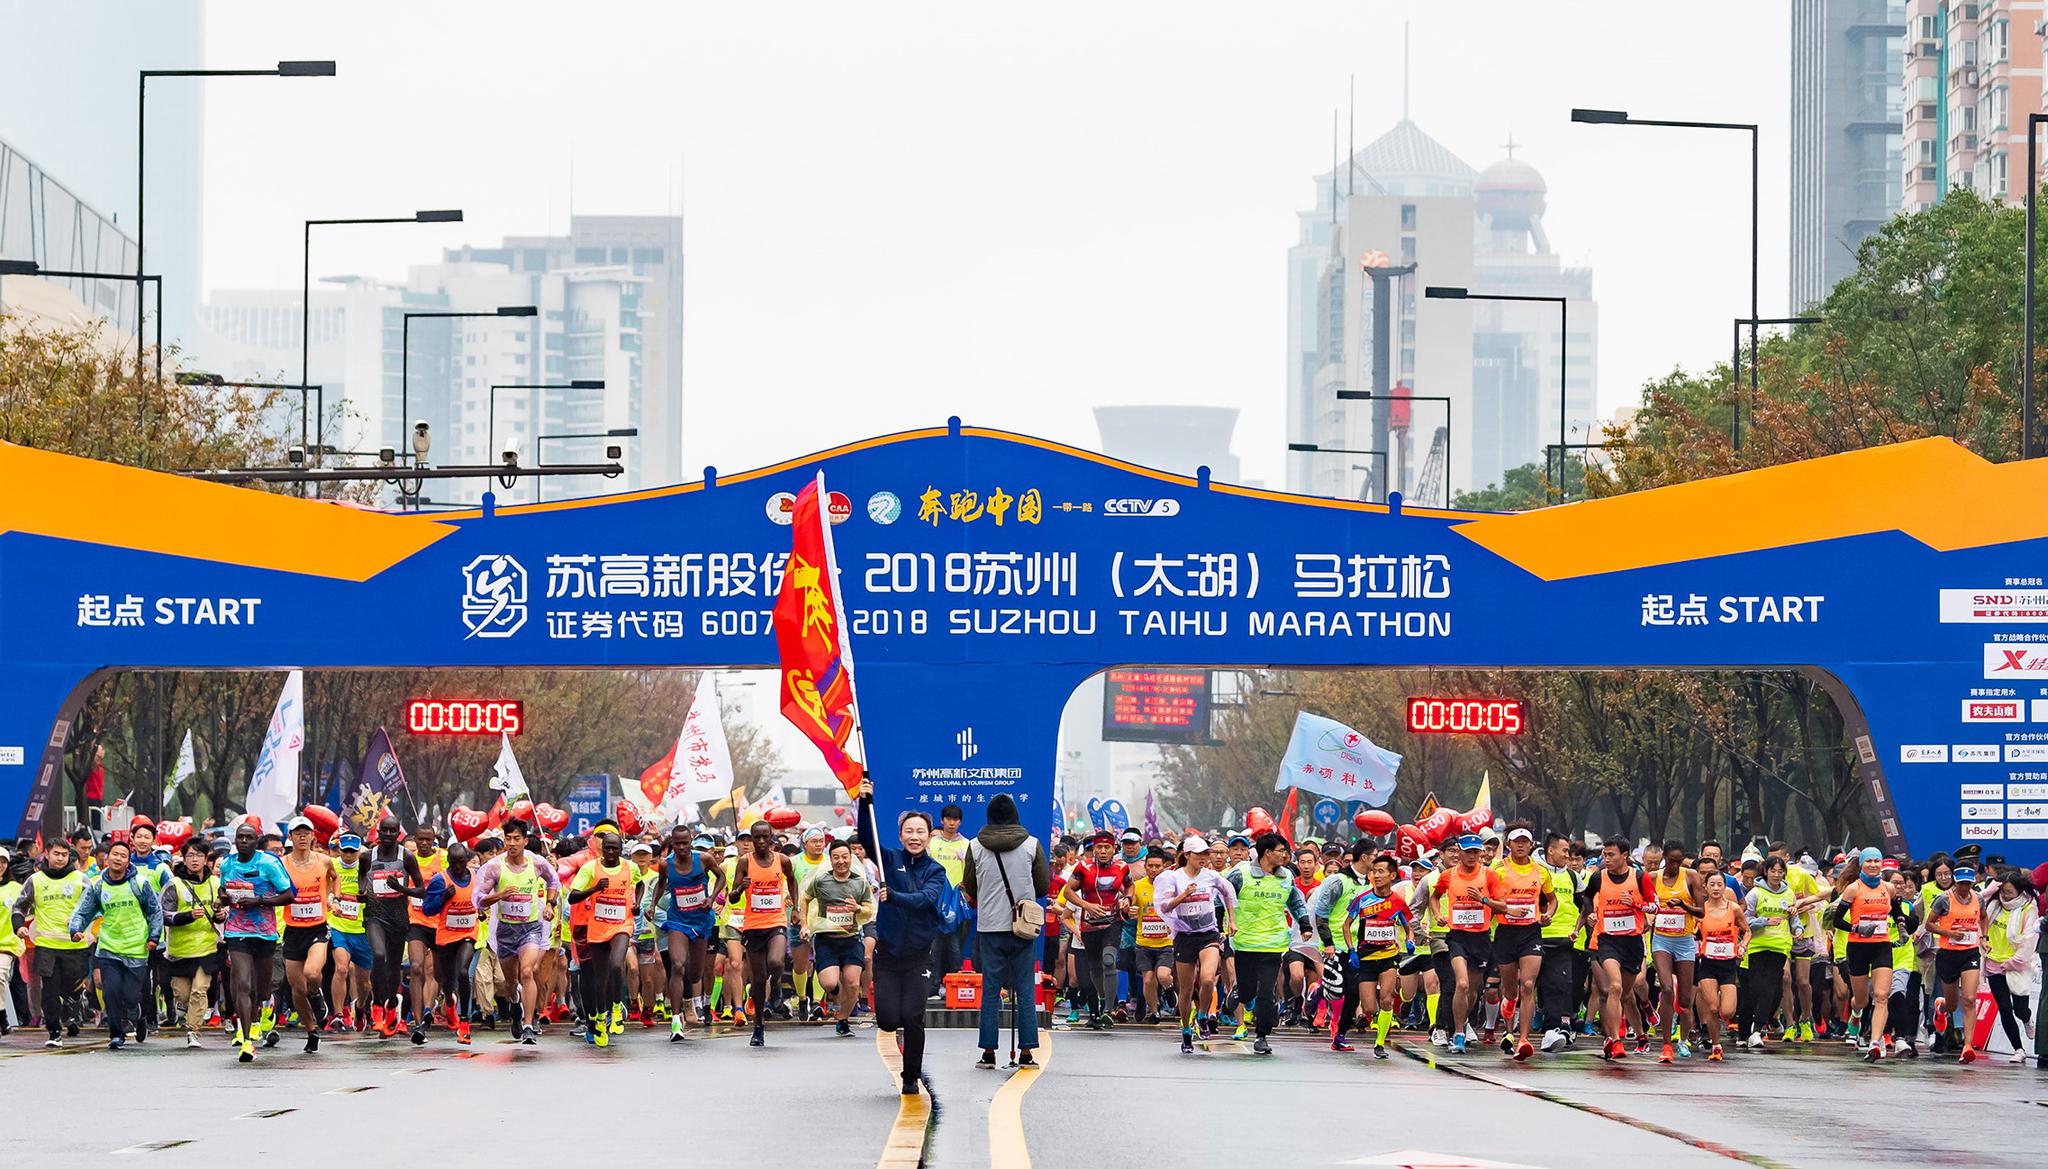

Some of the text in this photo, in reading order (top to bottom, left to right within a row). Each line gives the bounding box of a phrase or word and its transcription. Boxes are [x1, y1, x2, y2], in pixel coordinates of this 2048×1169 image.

[918, 485, 1042, 528] 奔跑中国
[1104, 499, 1153, 513] CCTV
[1973, 595, 2013, 605] SND
[77, 594, 262, 627] 起点 START
[1640, 593, 1825, 627] 起点 START
[546, 610, 684, 639] 证券代码
[851, 608, 1452, 637] 2018 SUZHOU TAIHU MARATHON
[1993, 633, 2048, 643] 官方战略合作伙
[410, 703, 519, 731] 00:00:05
[1411, 701, 1519, 731] 00:00:05
[451, 812, 480, 828] 4:30
[1461, 811, 1490, 831] 4:00
[1966, 826, 1998, 836] InBody
[300, 907, 313, 915] 112
[510, 905, 524, 913] 113
[1366, 929, 1393, 938] A01849
